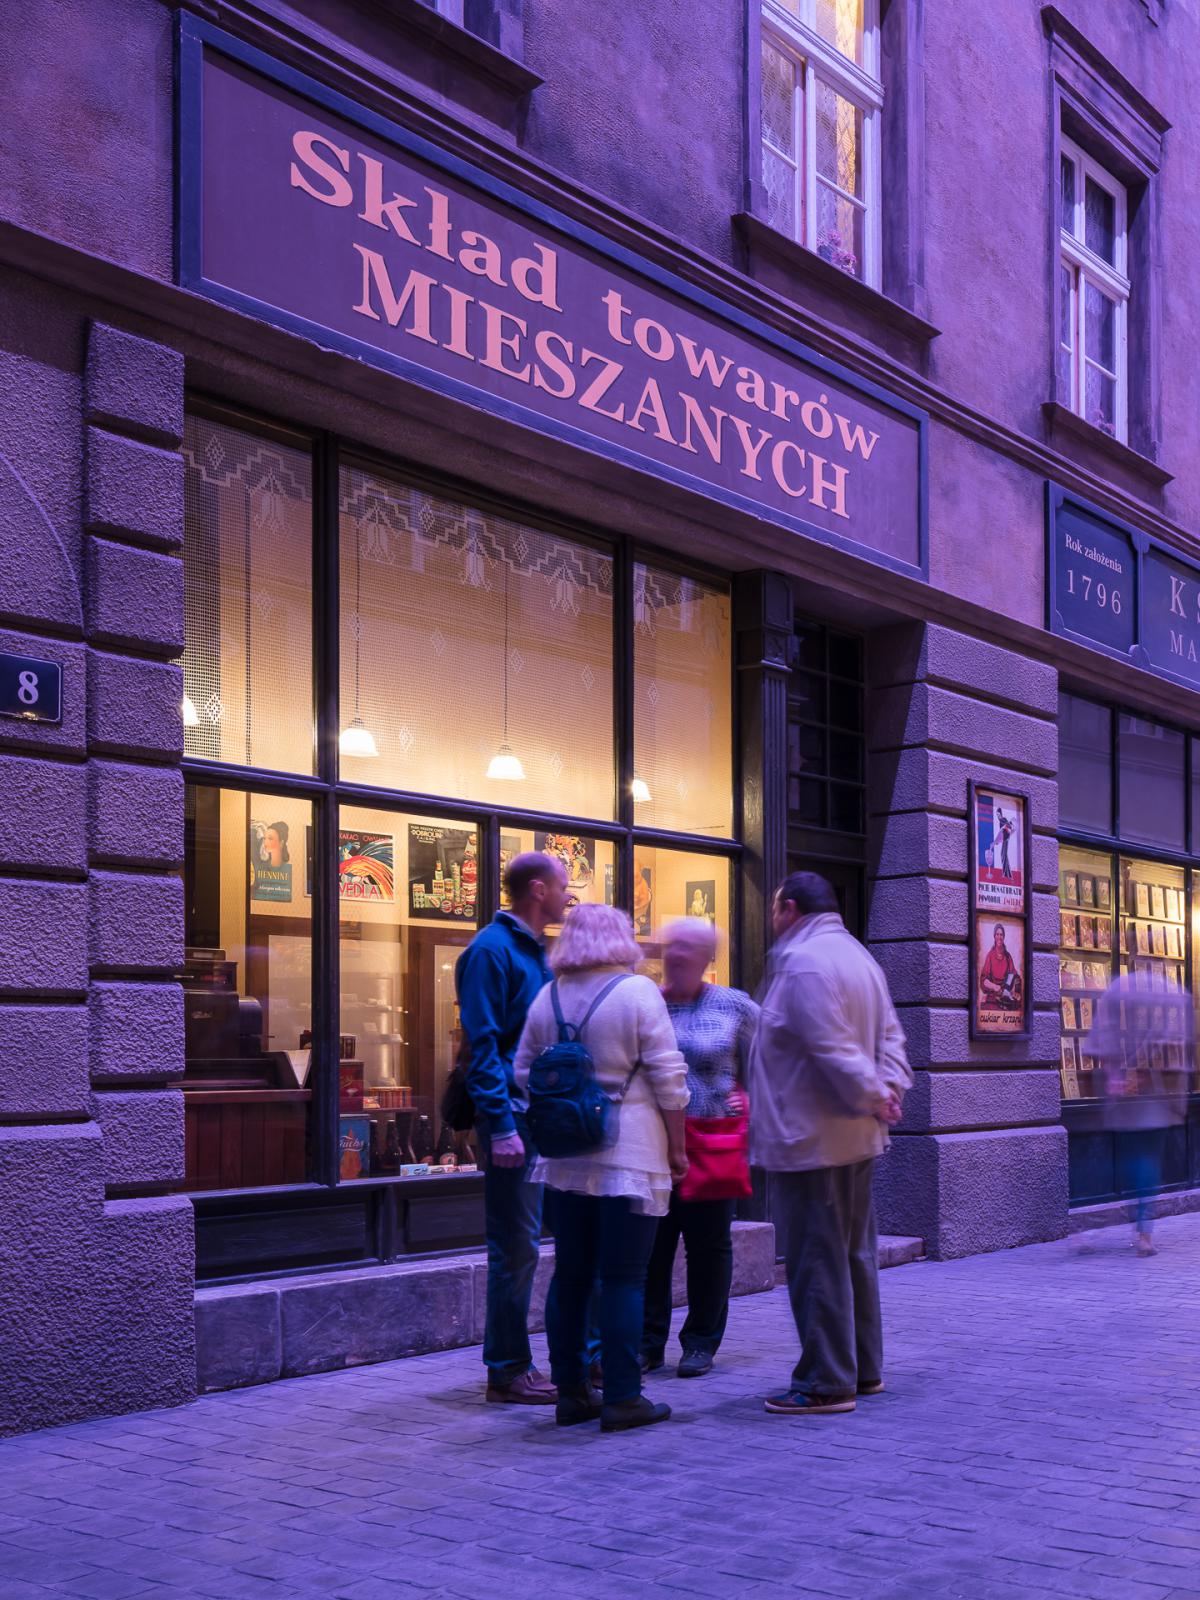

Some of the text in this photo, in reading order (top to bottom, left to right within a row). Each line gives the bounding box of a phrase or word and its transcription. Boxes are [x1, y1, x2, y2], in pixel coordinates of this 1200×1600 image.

[290, 130, 881, 462] Skład towarów
[352, 243, 851, 519] MIESZANYCH
[1065, 533, 1122, 574] Rok założenia
[1067, 569, 1122, 615] 1796
[18, 671, 38, 704] 8
